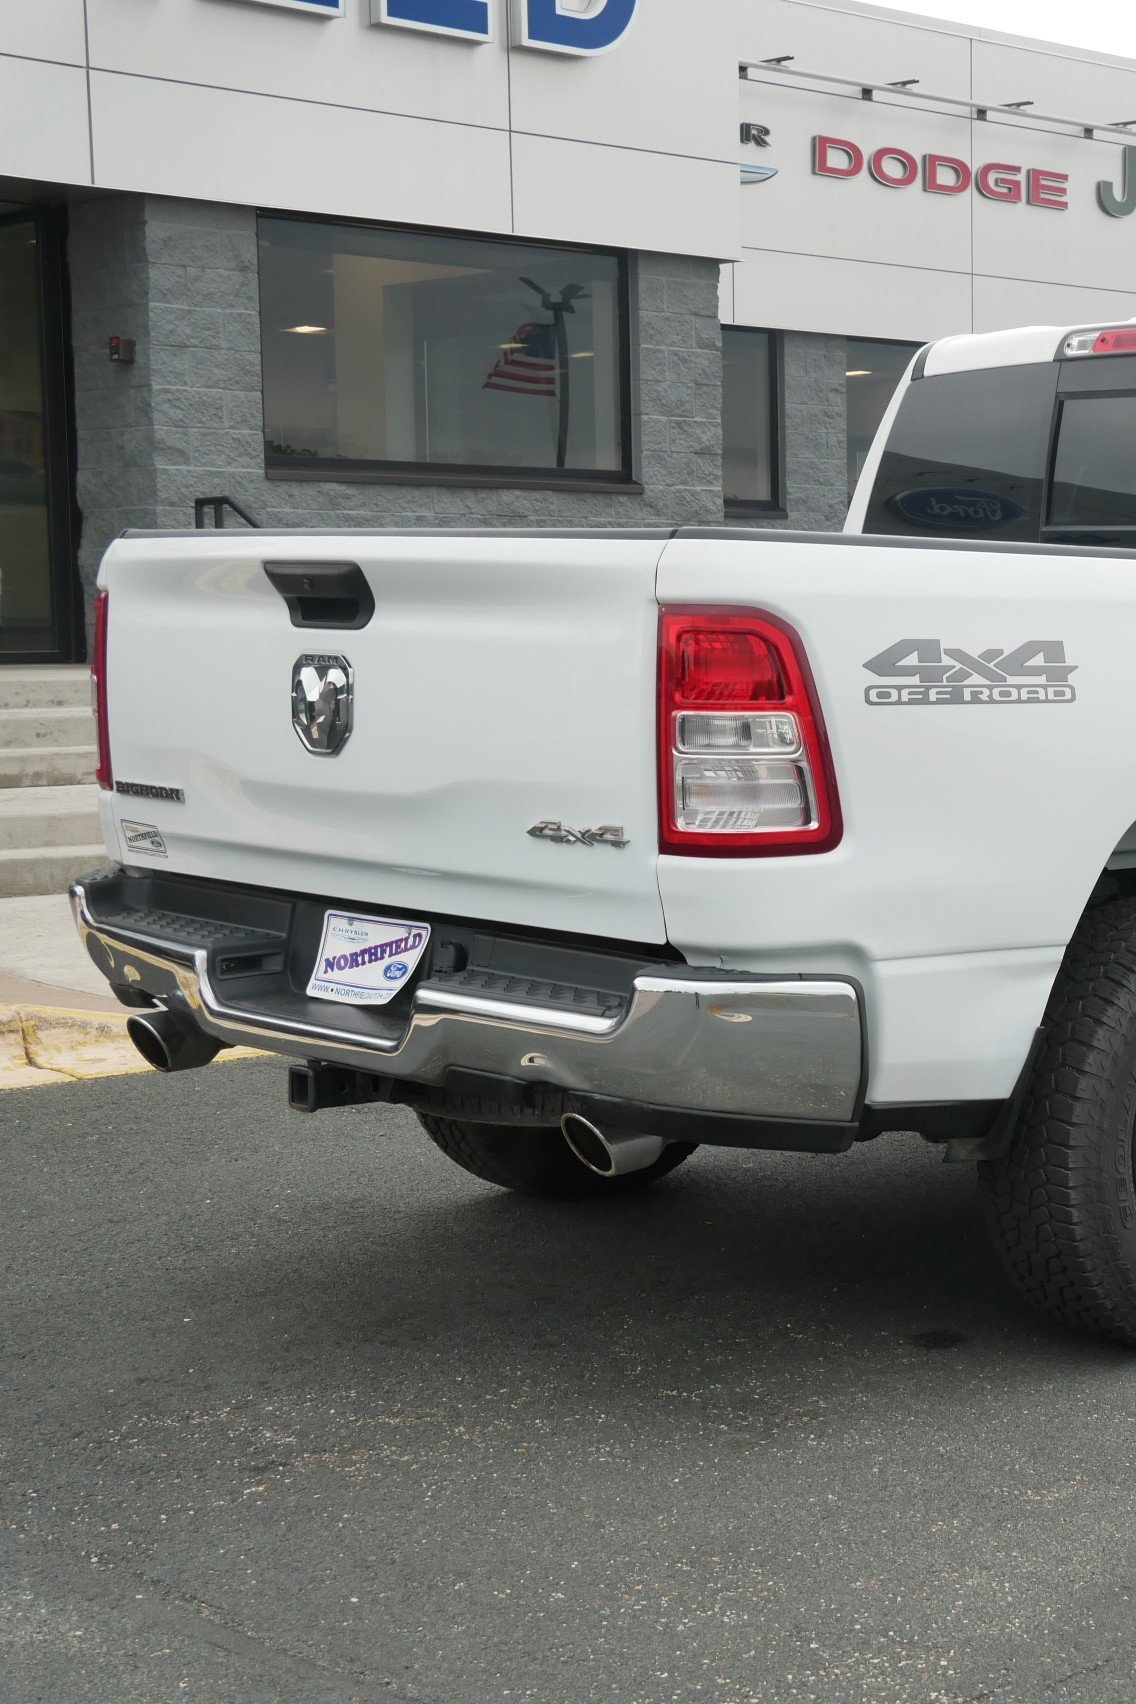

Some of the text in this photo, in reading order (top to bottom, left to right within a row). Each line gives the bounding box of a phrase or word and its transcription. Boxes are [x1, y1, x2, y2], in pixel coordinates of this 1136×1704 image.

[812, 135, 1068, 210] DODGE
[303, 655, 340, 665] RAM
[868, 686, 1073, 703] OFF ROAD
[115, 780, 184, 803] BIGHORN
[332, 926, 369, 937] CHRYSLER
[323, 932, 424, 974] NORTHFIELD
